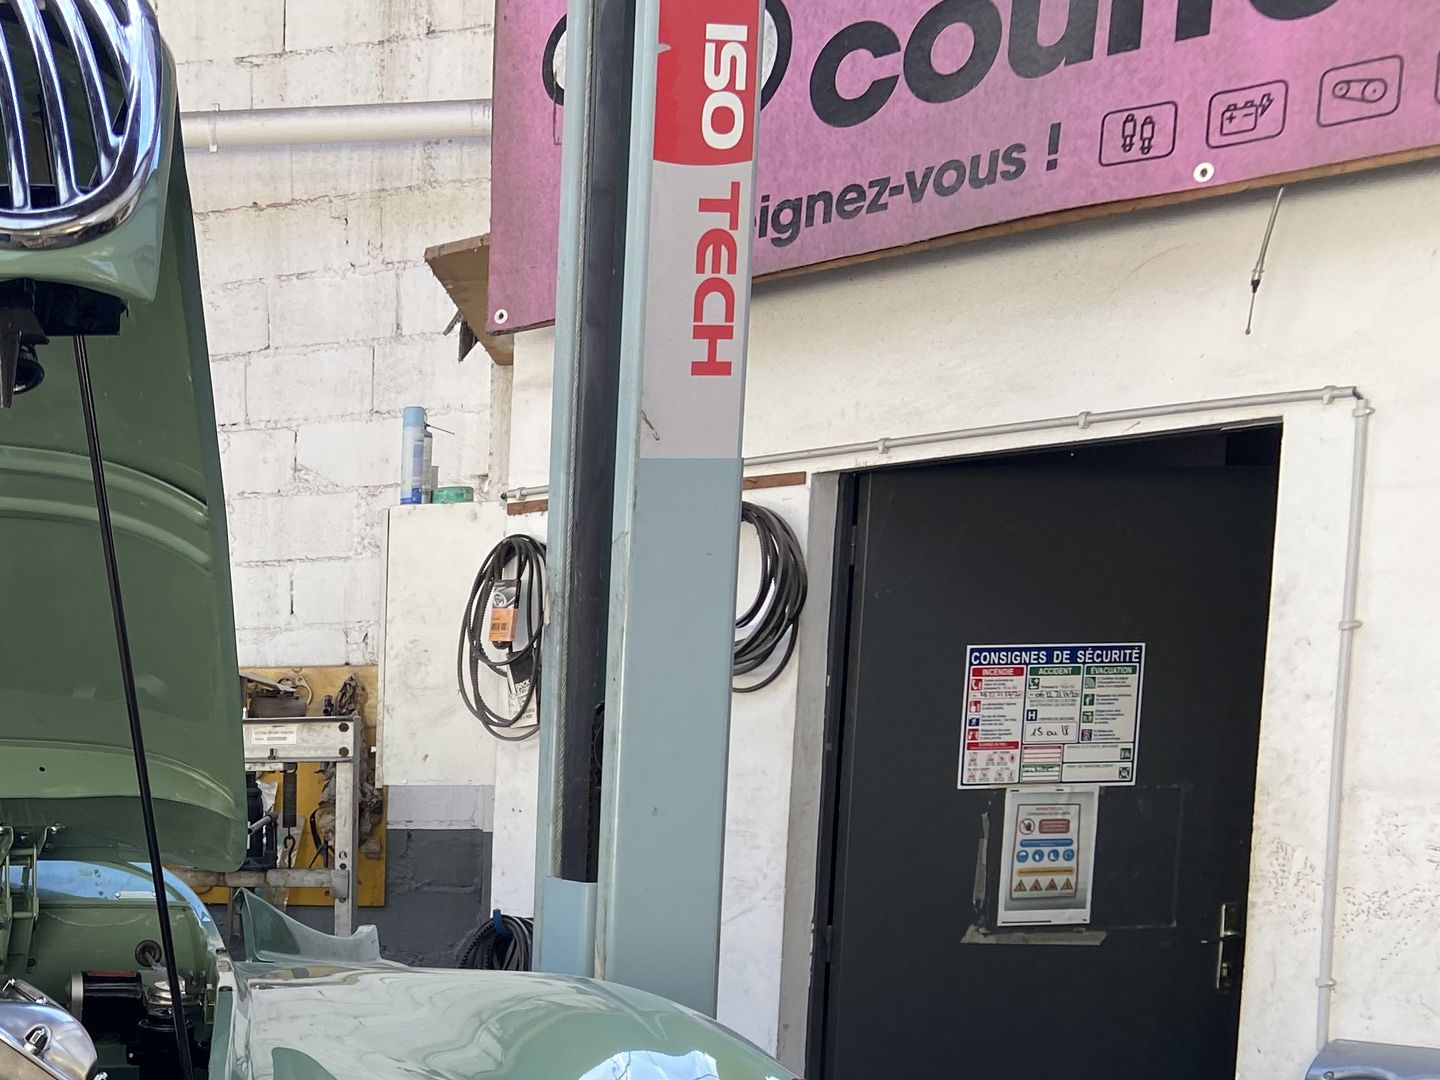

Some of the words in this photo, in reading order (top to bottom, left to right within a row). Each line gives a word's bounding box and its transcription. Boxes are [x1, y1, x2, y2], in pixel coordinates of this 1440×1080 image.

[701, 23, 748, 150] ISO
[810, 0, 1338, 128] cou
[753, 142, 1027, 248] ignez-vous
[1046, 122, 1062, 171] !
[691, 181, 741, 376] TECH
[971, 651, 1047, 665] CONSIGNES
[1053, 650, 1071, 664] DE
[1076, 647, 1140, 663] SÉCURITÉ
[982, 668, 1015, 676] INCENDIE
[1038, 667, 1073, 675] ACCIDENT
[1090, 665, 1132, 675] ÉVACUATION
